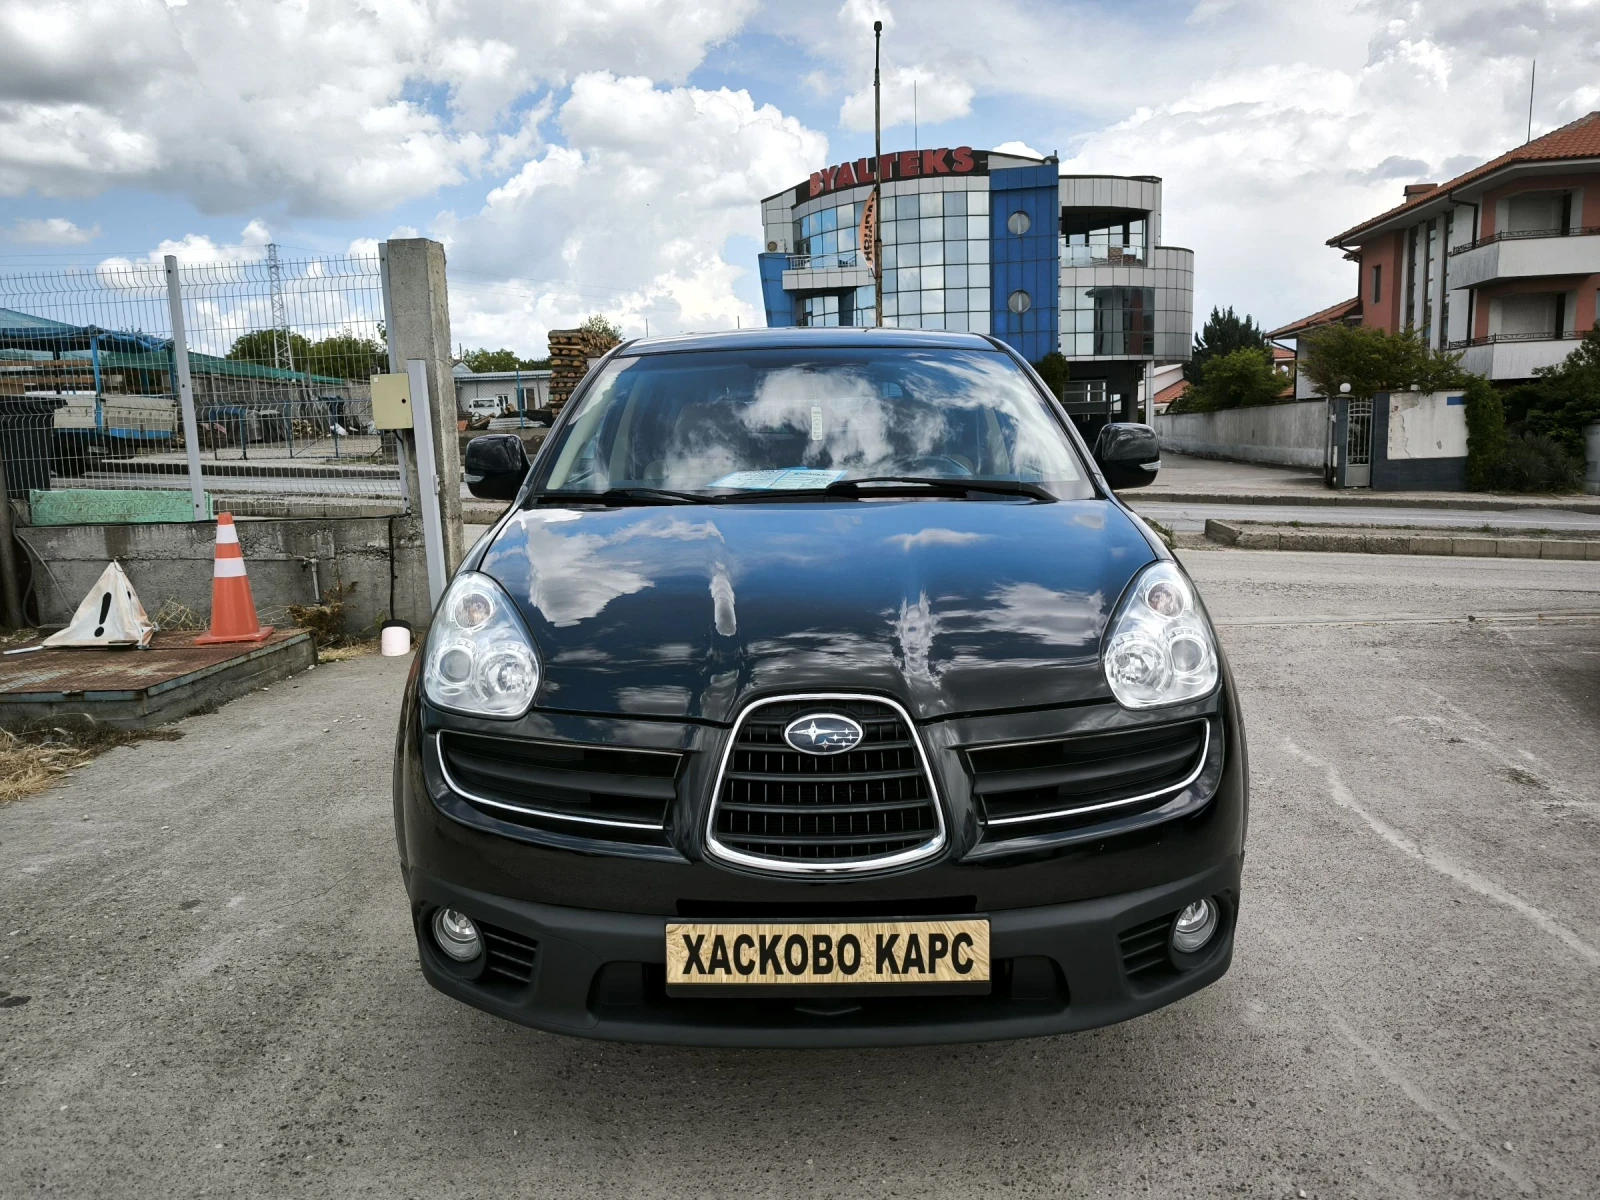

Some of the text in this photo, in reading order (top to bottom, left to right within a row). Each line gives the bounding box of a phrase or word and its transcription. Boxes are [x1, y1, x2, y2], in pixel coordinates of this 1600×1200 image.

[809, 146, 975, 197] BYALTEKS
[682, 932, 974, 975] ХАСКОВО КАРС
